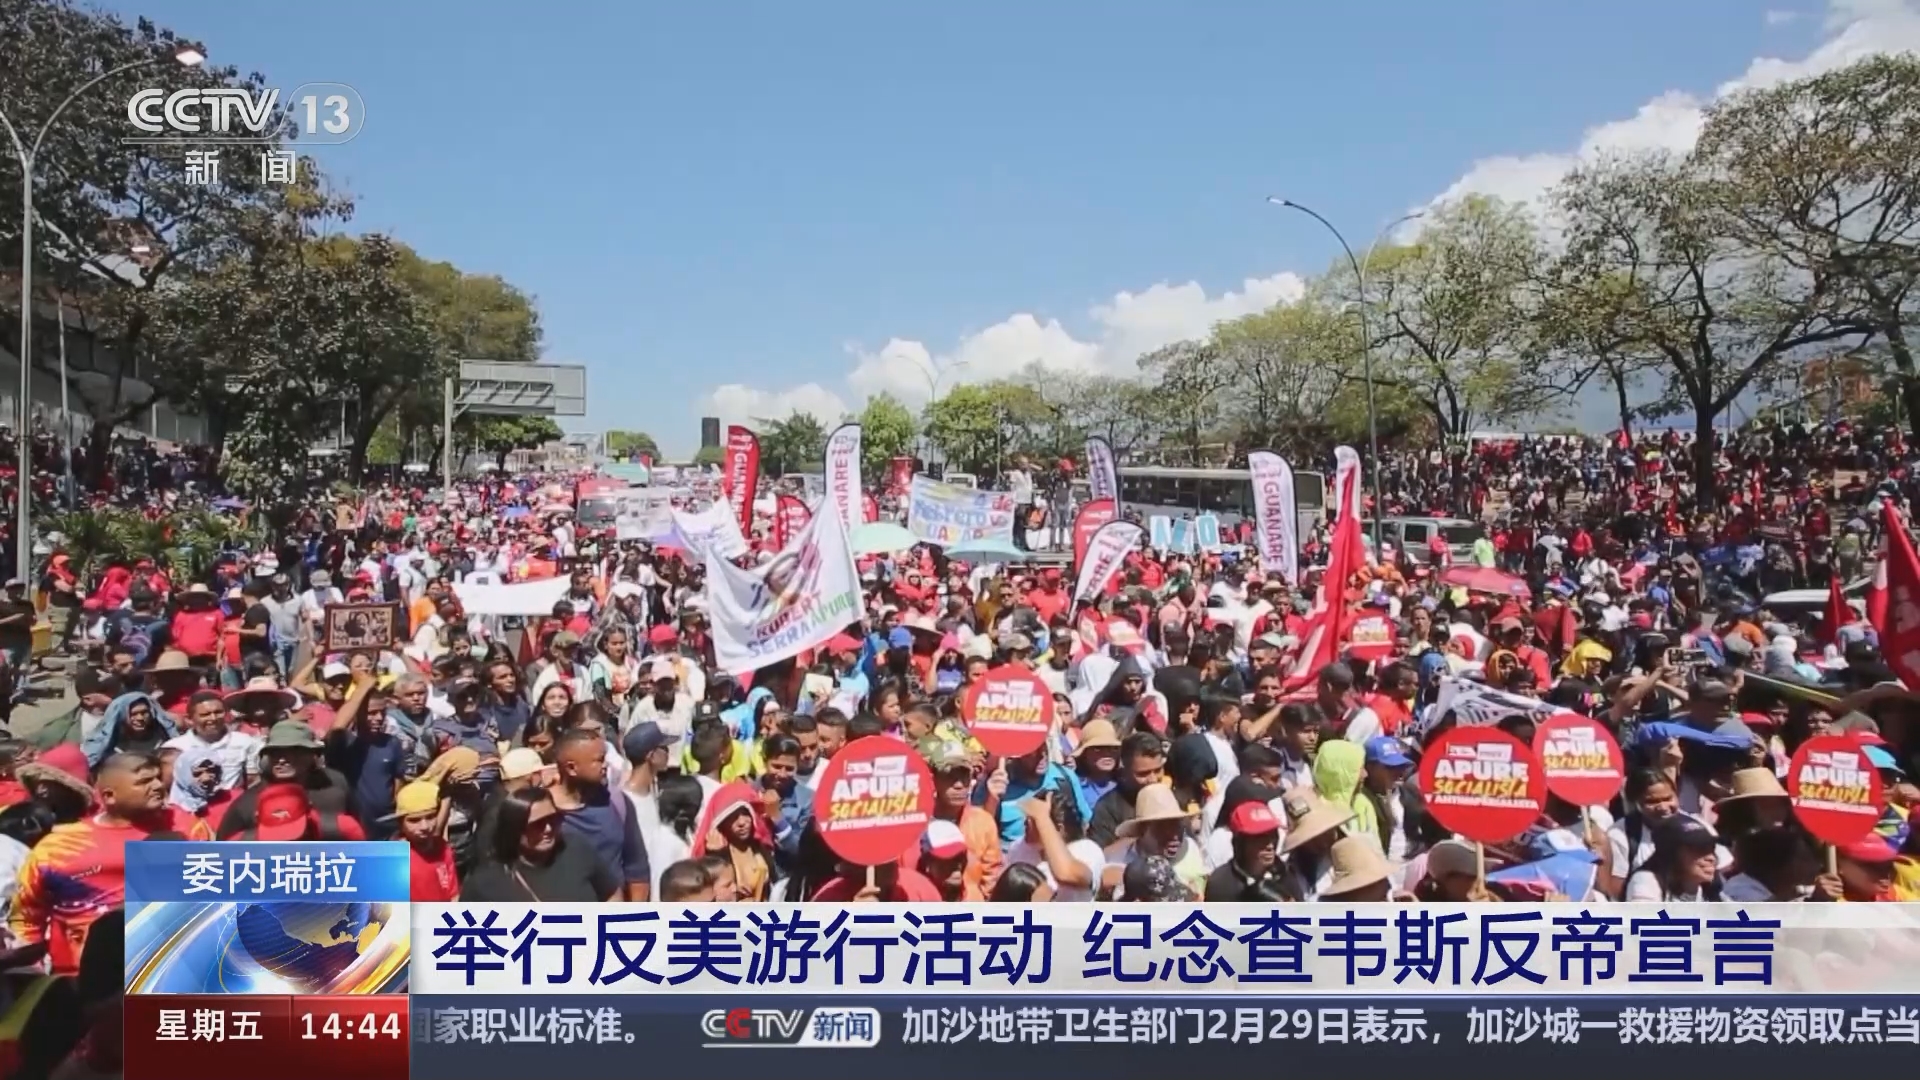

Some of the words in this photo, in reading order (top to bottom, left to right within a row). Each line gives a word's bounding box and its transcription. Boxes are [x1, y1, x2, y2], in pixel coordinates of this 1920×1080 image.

[1263, 482, 1284, 565] GUANARE
[976, 692, 1044, 710] APURE
[1543, 740, 1609, 757] APURE
[1434, 759, 1529, 782] APURE
[1799, 764, 1871, 789] APURE
[831, 773, 920, 802] APURE
[1432, 777, 1527, 798] SOCIALISTA
[829, 791, 918, 821] SOCIALISTA
